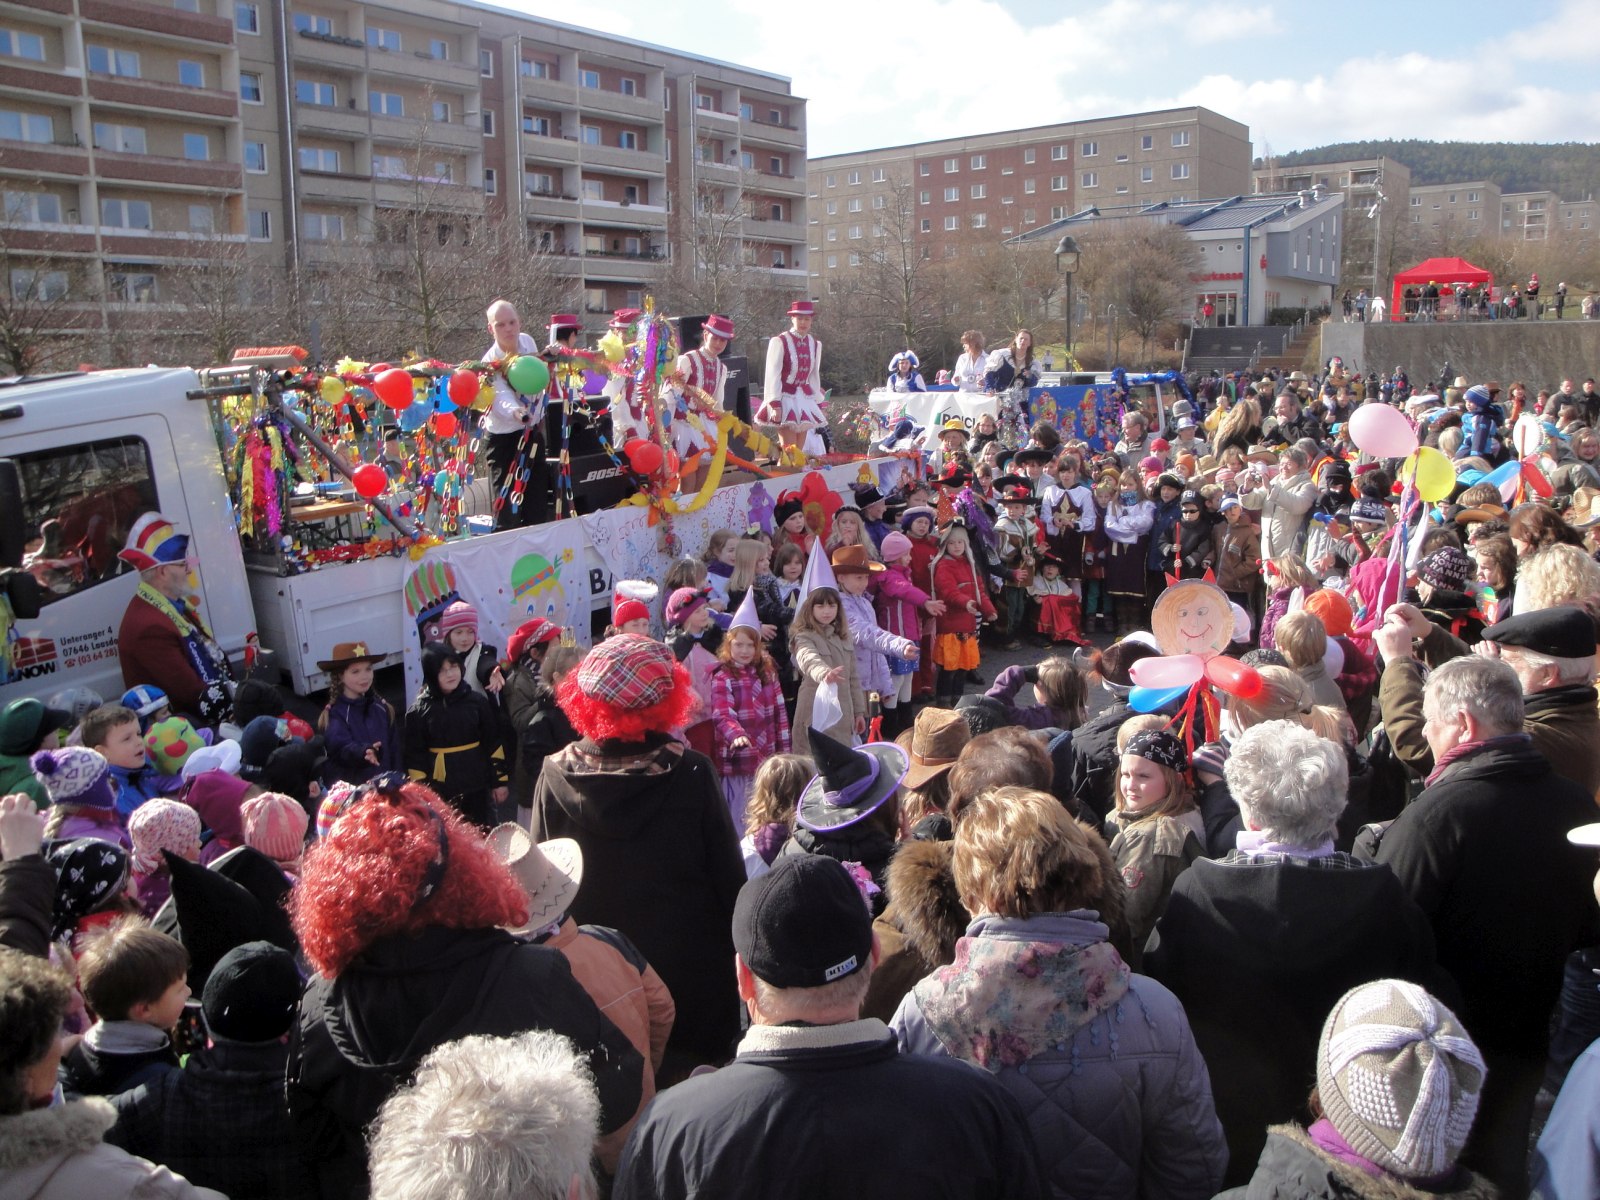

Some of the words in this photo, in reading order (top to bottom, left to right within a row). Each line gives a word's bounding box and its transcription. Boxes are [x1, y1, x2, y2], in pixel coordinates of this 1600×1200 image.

[579, 465, 629, 483] BOSE
[1183, 490, 1196, 498] FBI
[1429, 561, 1467, 580] HANNA
[60, 630, 105, 646] Unteranger
[107, 625, 113, 634] 4
[62, 643, 89, 657] 07646
[91, 637, 119, 650] Laasdo
[93, 651, 103, 661] 64
